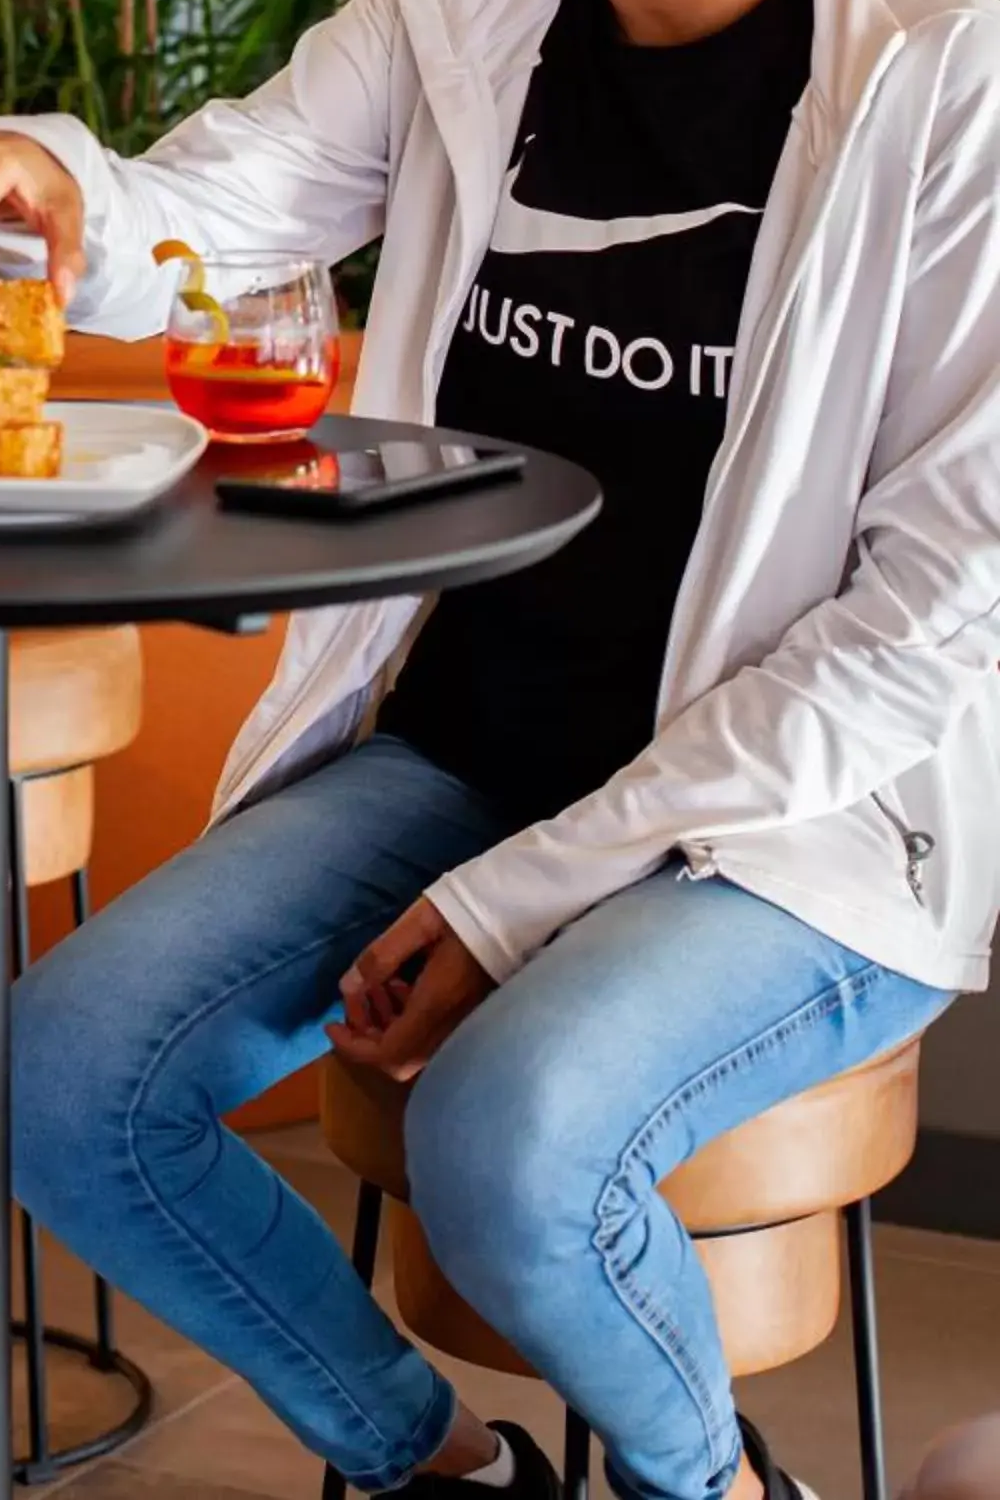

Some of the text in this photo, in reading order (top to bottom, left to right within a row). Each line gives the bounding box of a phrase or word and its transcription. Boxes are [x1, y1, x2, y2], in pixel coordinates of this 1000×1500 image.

[463, 284, 734, 398] JUST DO IT
